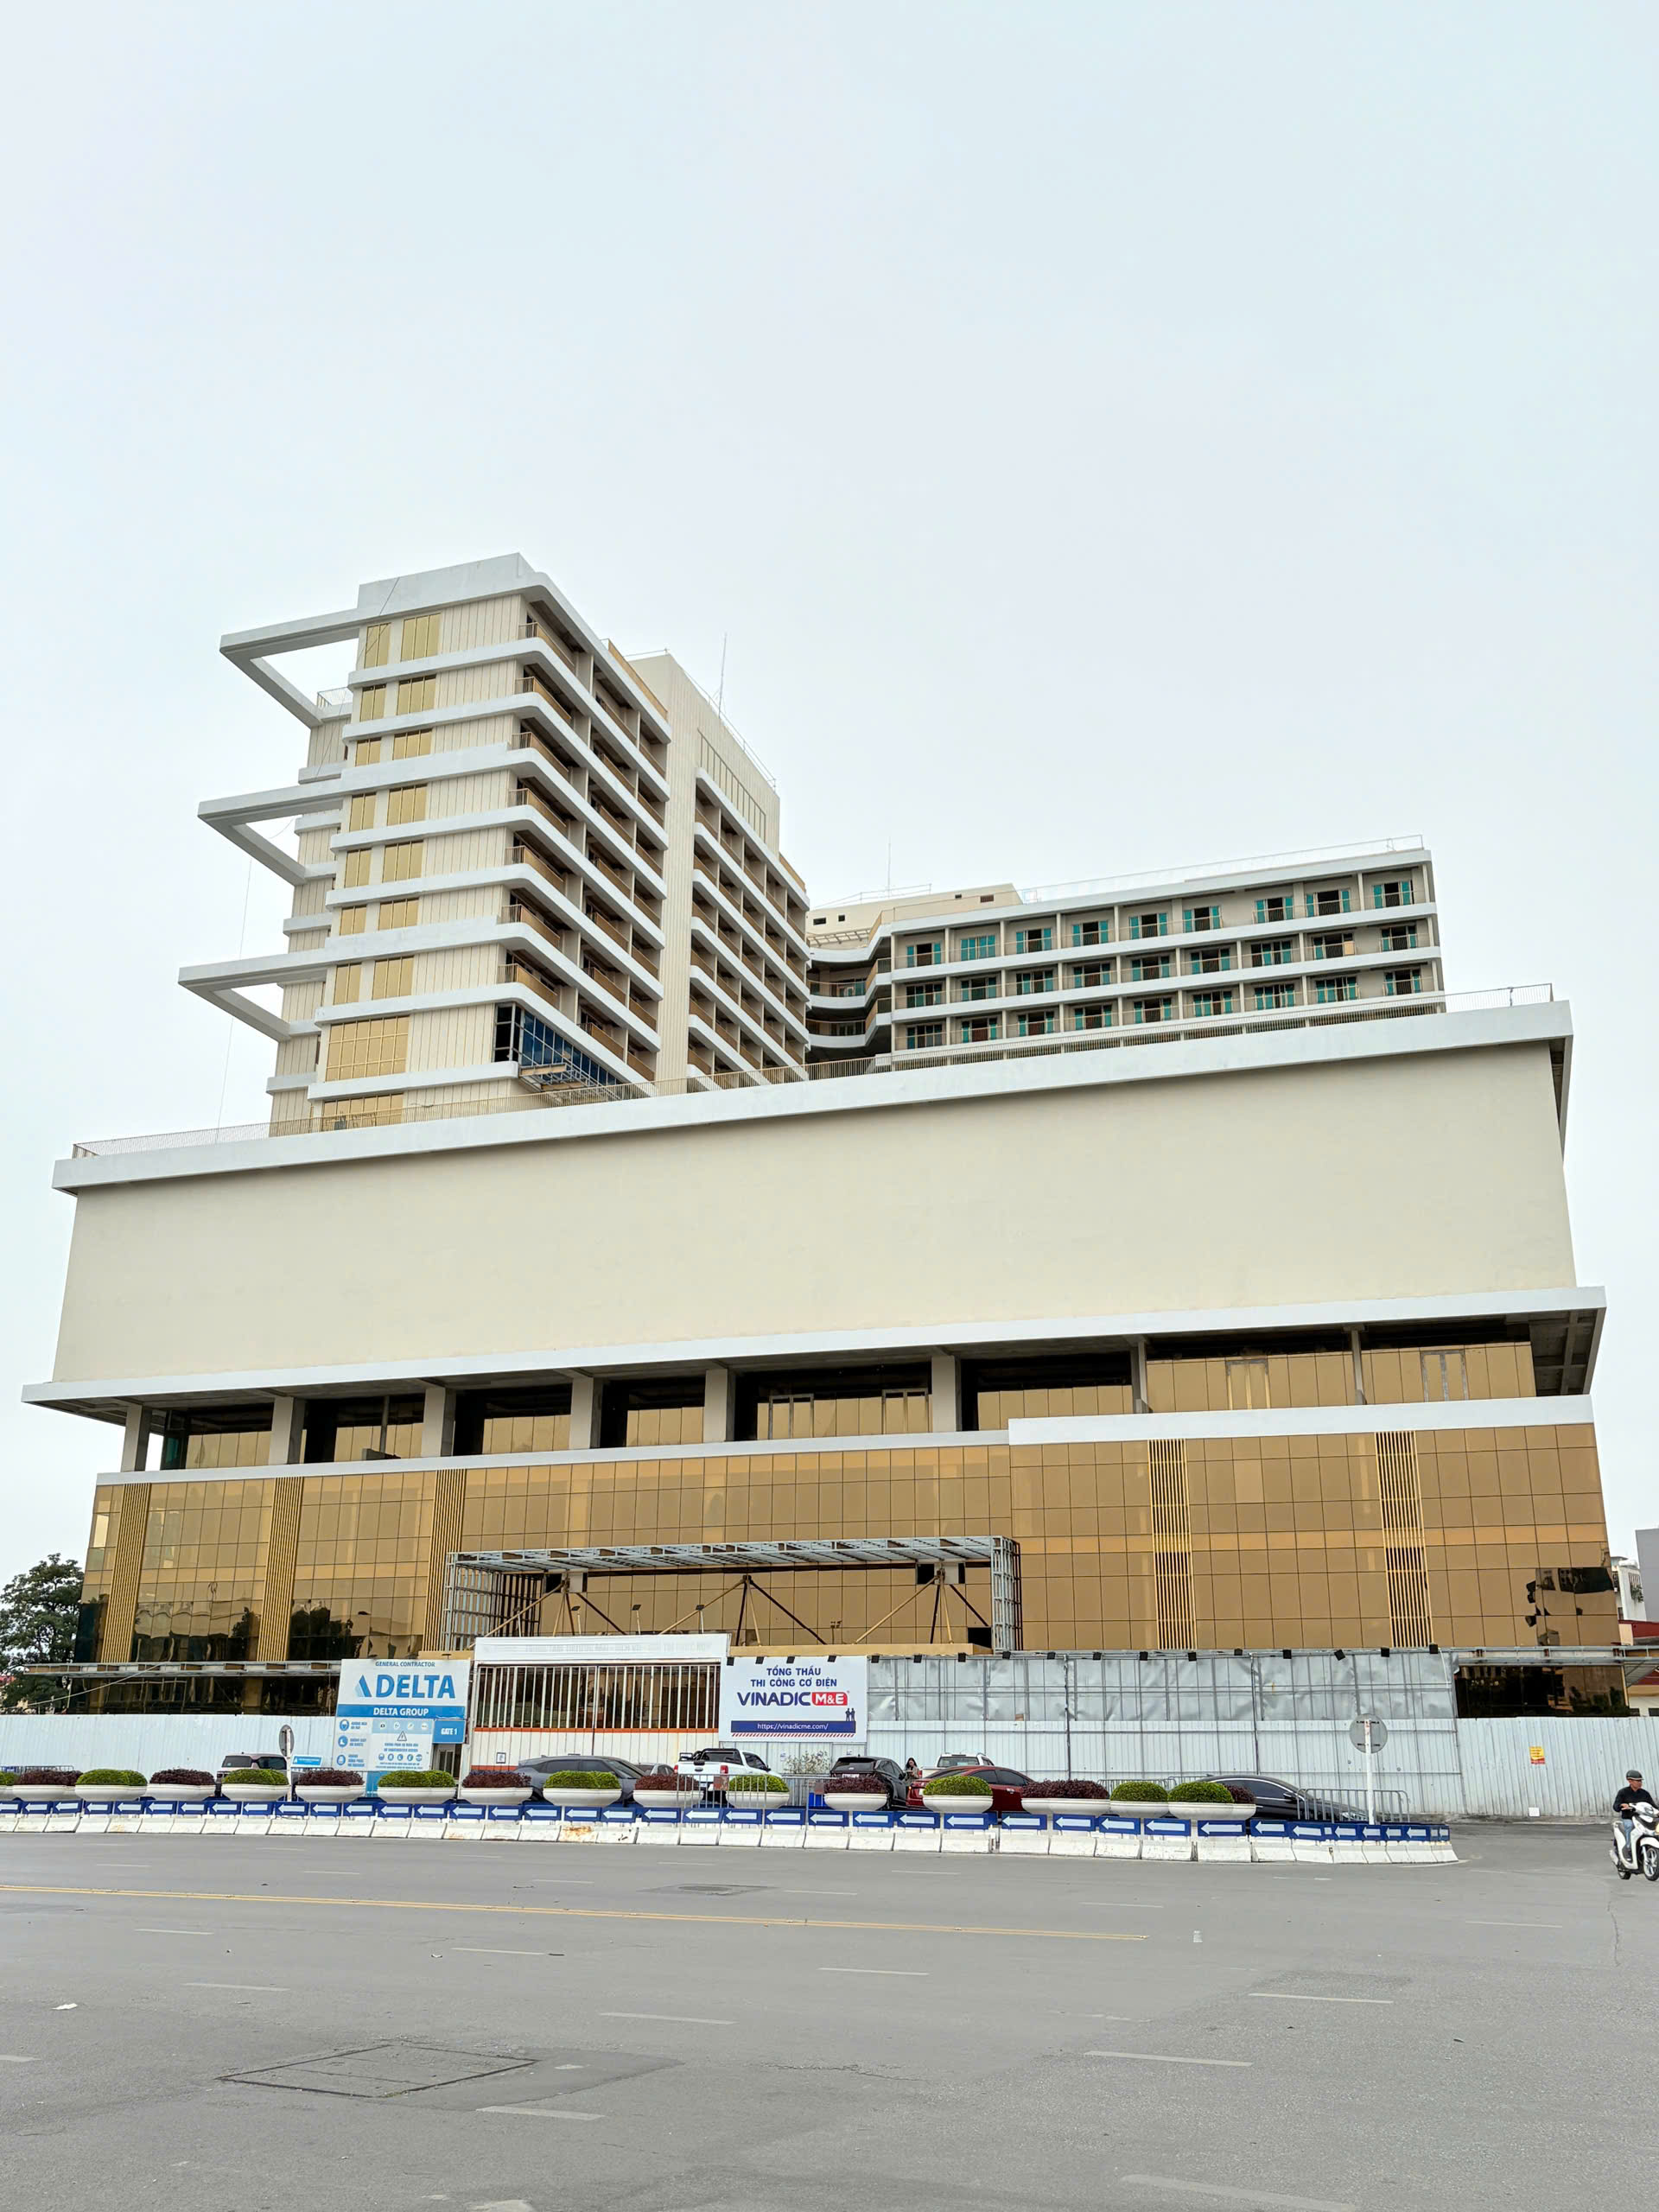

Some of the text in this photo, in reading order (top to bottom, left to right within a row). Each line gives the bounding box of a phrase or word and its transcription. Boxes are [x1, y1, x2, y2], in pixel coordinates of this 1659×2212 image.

[766, 1664, 791, 1676] TỔNG
[376, 1675, 455, 1699] DELTA
[751, 1677, 837, 1689] THI CÔNG CƠ ĐIỆN
[737, 1692, 844, 1707] VINADIC M&E
[373, 1707, 429, 1717] DELTA GROUP
